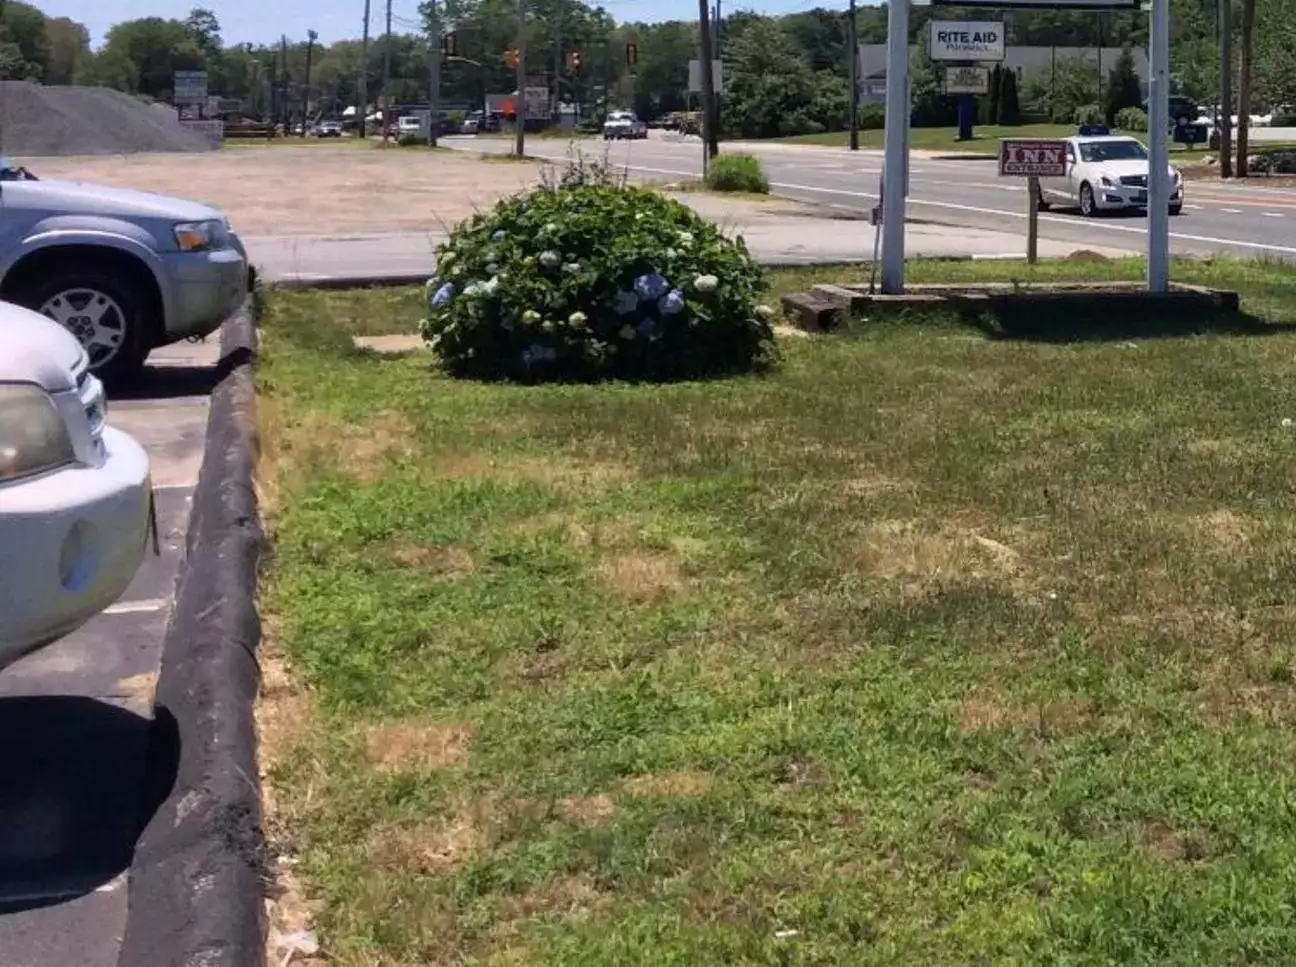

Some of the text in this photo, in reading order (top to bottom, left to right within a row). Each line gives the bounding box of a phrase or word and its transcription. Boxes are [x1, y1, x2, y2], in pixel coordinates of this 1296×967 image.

[938, 31, 997, 43] RITE AID
[1007, 147, 1062, 162] INN
